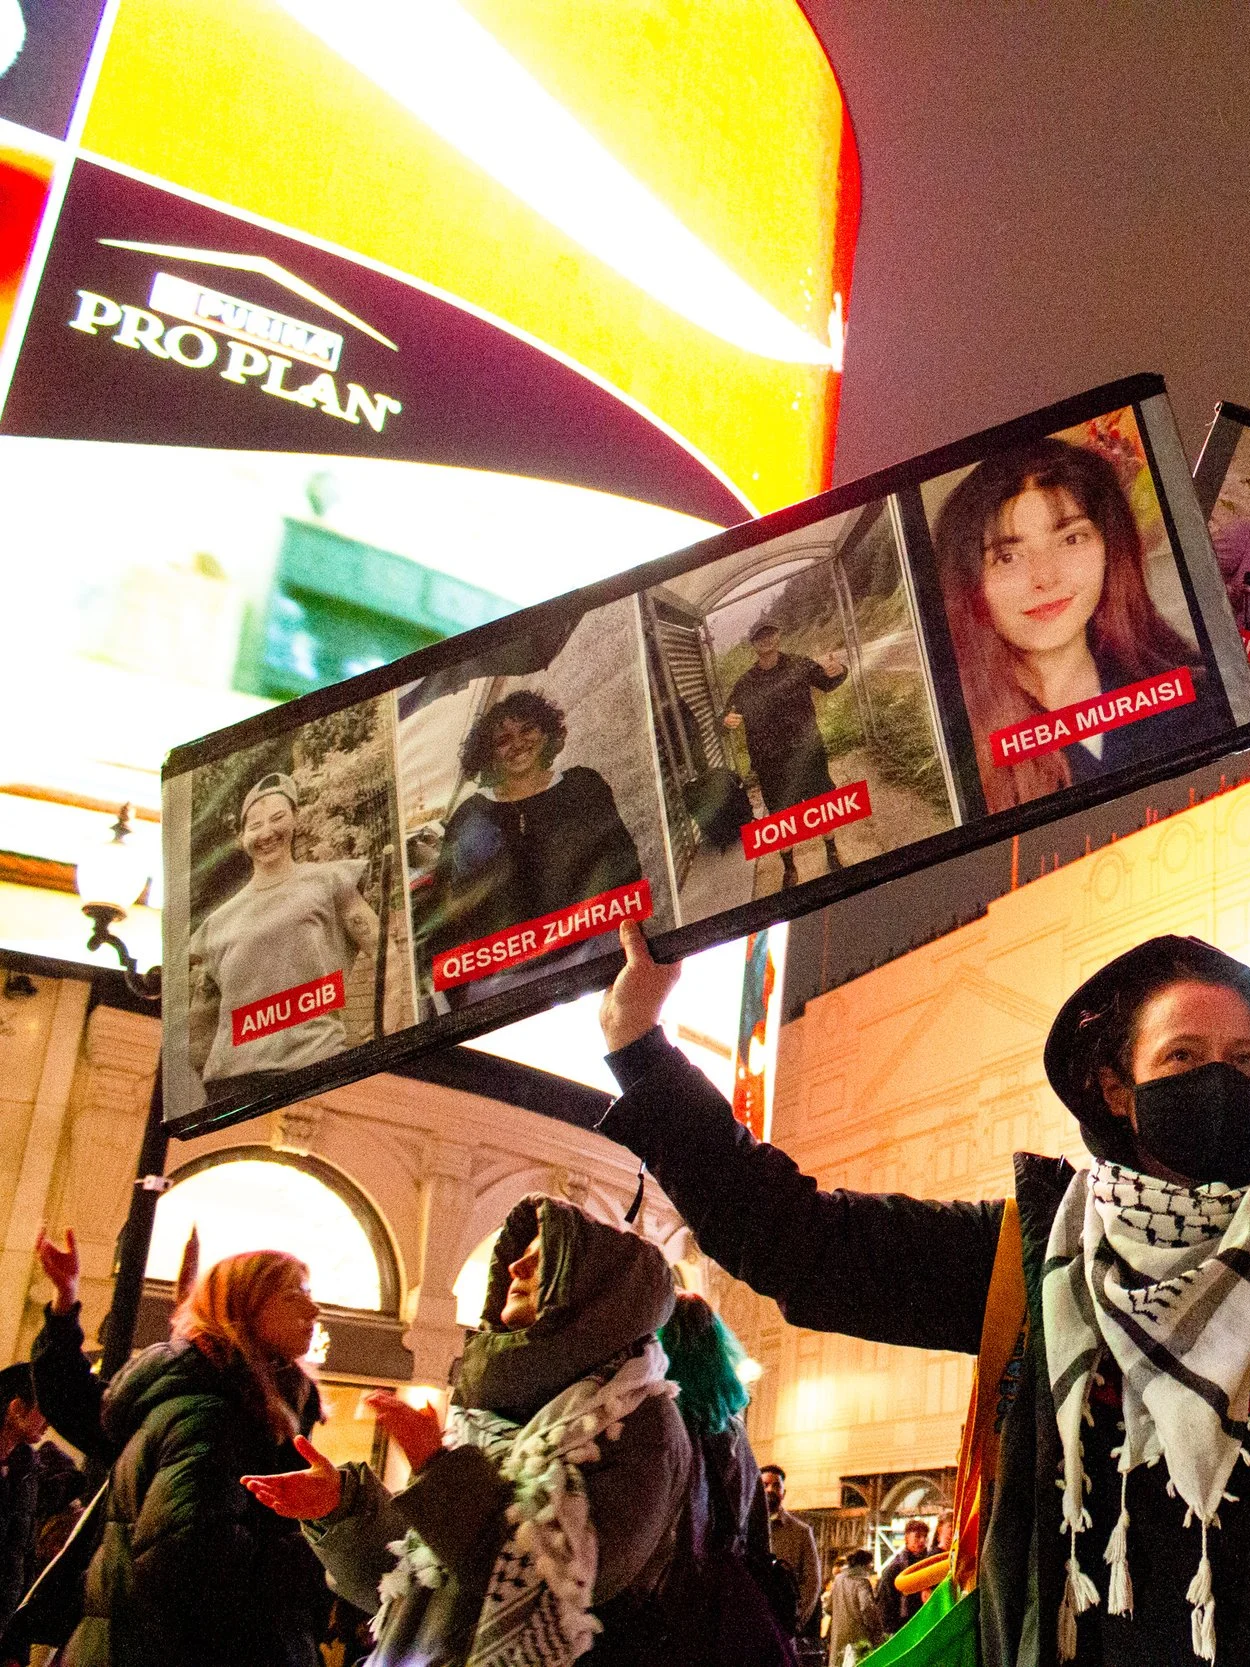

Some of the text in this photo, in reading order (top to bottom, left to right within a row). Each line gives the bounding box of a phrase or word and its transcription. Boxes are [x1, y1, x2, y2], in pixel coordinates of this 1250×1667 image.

[68, 290, 218, 368] PRO
[1001, 678, 1184, 757] HEBA MURAISI
[753, 791, 861, 849] JON CINK
[442, 891, 643, 979] QESSER ZUHRAH
[241, 983, 337, 1036] AMU GIB
